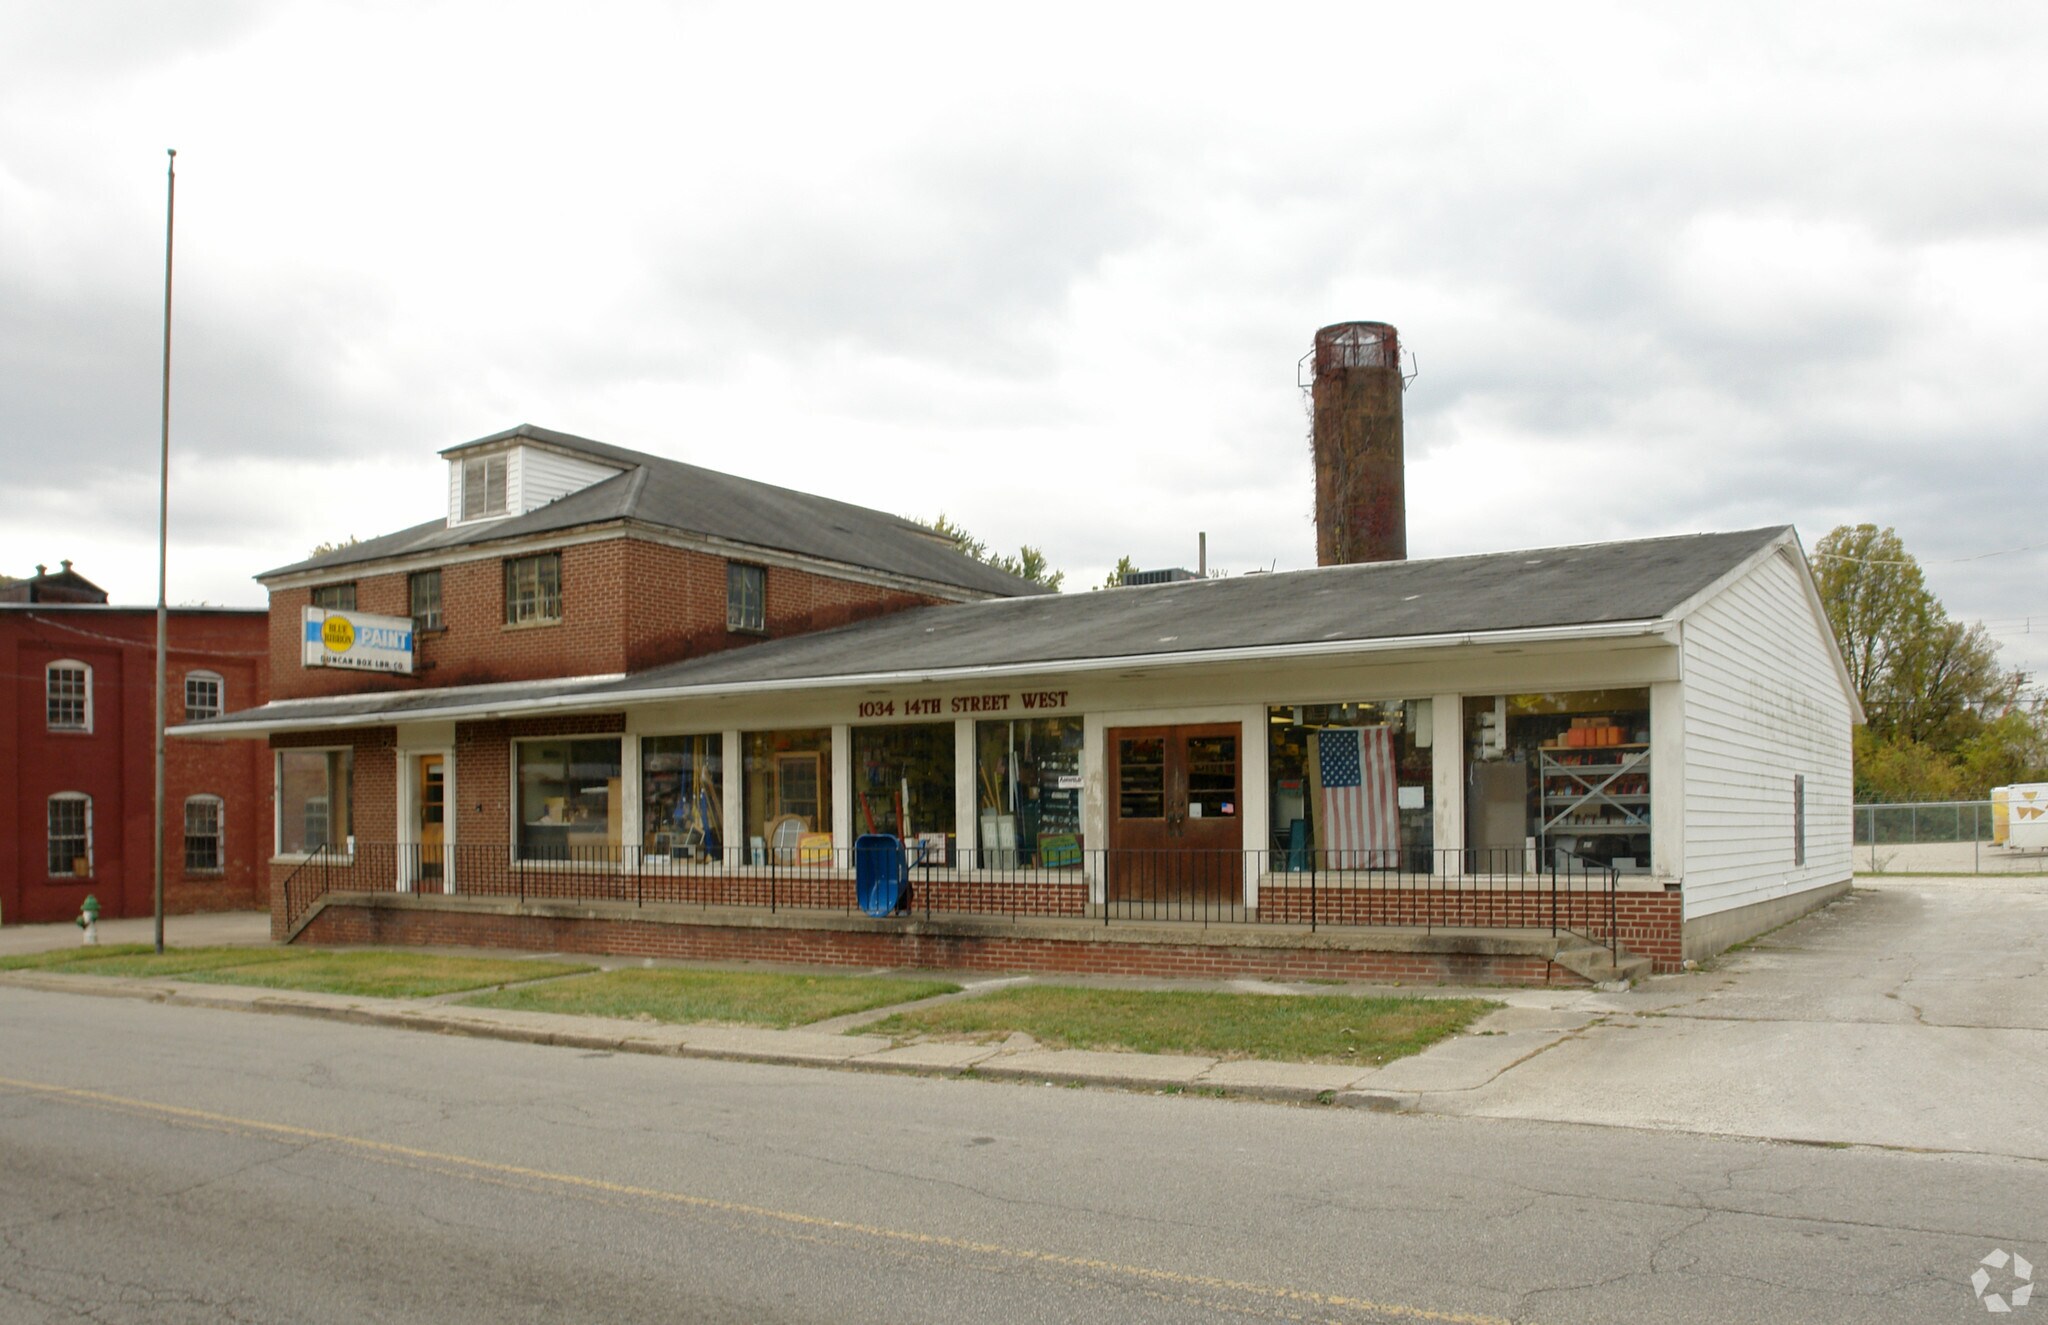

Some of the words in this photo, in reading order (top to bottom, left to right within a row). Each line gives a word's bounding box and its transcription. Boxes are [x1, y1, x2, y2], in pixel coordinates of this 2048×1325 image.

[361, 628, 407, 649] PAINT
[321, 655, 353, 665] DUNCAN
[357, 658, 372, 666] BOX
[858, 701, 895, 717] 1034
[904, 698, 941, 715] 14TH
[951, 695, 1010, 712] STREET
[1021, 691, 1068, 709] WEST
